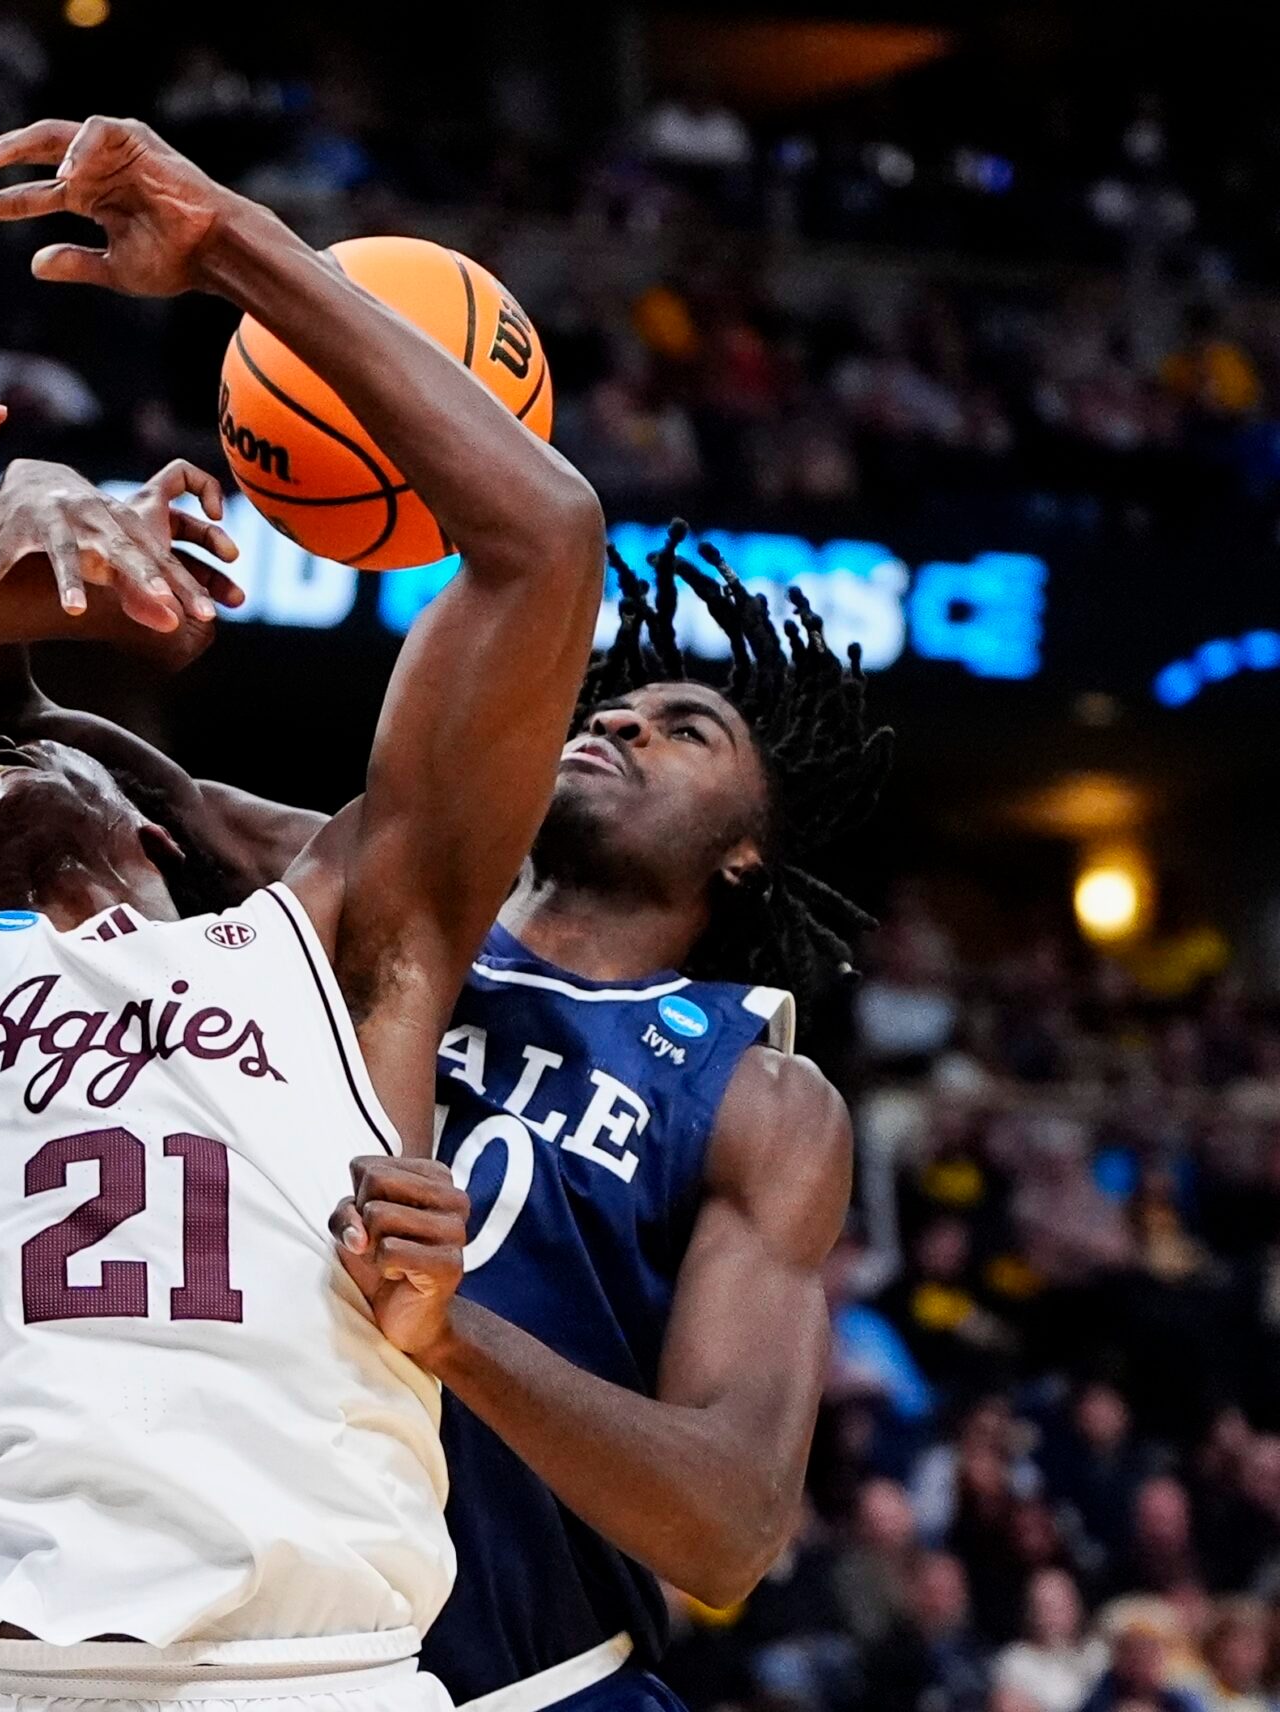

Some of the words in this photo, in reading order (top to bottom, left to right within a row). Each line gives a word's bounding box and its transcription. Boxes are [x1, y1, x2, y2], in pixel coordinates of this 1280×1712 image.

[211, 924, 250, 945] SEC
[436, 1024, 651, 1184] ALE
[641, 1023, 674, 1057] Ivy
[21, 1126, 243, 1325] 21
[431, 1104, 535, 1273] 0
